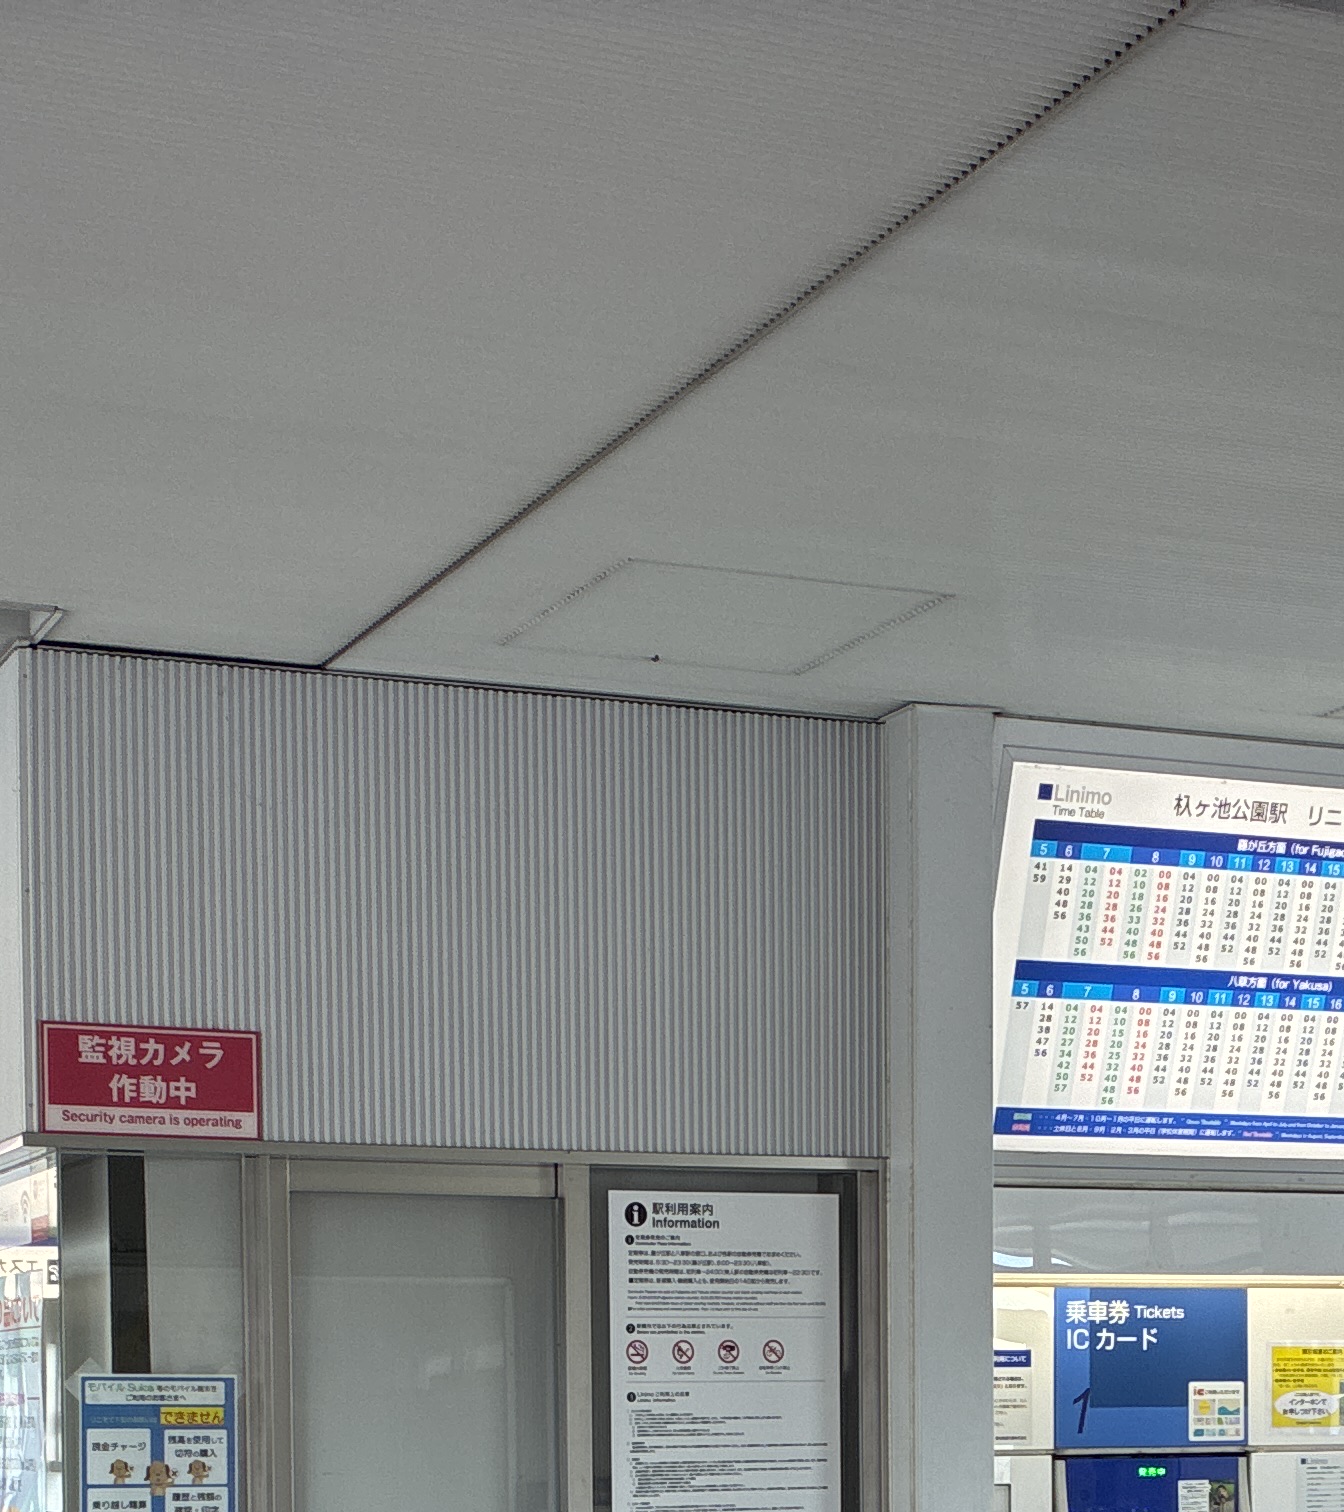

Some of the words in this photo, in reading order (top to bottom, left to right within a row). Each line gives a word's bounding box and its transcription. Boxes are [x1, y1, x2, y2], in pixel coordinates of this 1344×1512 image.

[1054, 784, 1112, 806] Linimo
[1052, 805, 1077, 817] Time
[1079, 807, 1105, 819] Table
[1040, 844, 1047, 855] 5
[1065, 845, 1073, 856] 6
[1103, 848, 1110, 859] 7
[1152, 851, 1160, 862] 8
[1188, 854, 1196, 865] 9
[1210, 855, 1223, 868] 10
[1234, 857, 1246, 868] 11
[1258, 859, 1271, 870] 12
[1281, 861, 1294, 872] 13
[1304, 862, 1317, 874] 14
[1327, 864, 1340, 876] 15
[1291, 843, 1310, 857] (for
[1271, 977, 1290, 990] (for
[1292, 978, 1333, 993] Yakusa)
[77, 1034, 225, 1069] 監視カメラ
[109, 1074, 197, 1106] 作動中
[62, 1109, 116, 1125] Security
[119, 1113, 165, 1126] camera
[169, 1113, 180, 1127] is
[184, 1115, 242, 1130] operating
[652, 1202, 714, 1216] 駅利用案内
[652, 1217, 719, 1229] Information
[1065, 1300, 1130, 1325] 乗車券
[1133, 1305, 1185, 1319] Tickets
[1066, 1329, 1090, 1349] IC
[1095, 1328, 1158, 1351] カード
[161, 1411, 223, 1424] できません
[1073, 1388, 1091, 1434] 1
